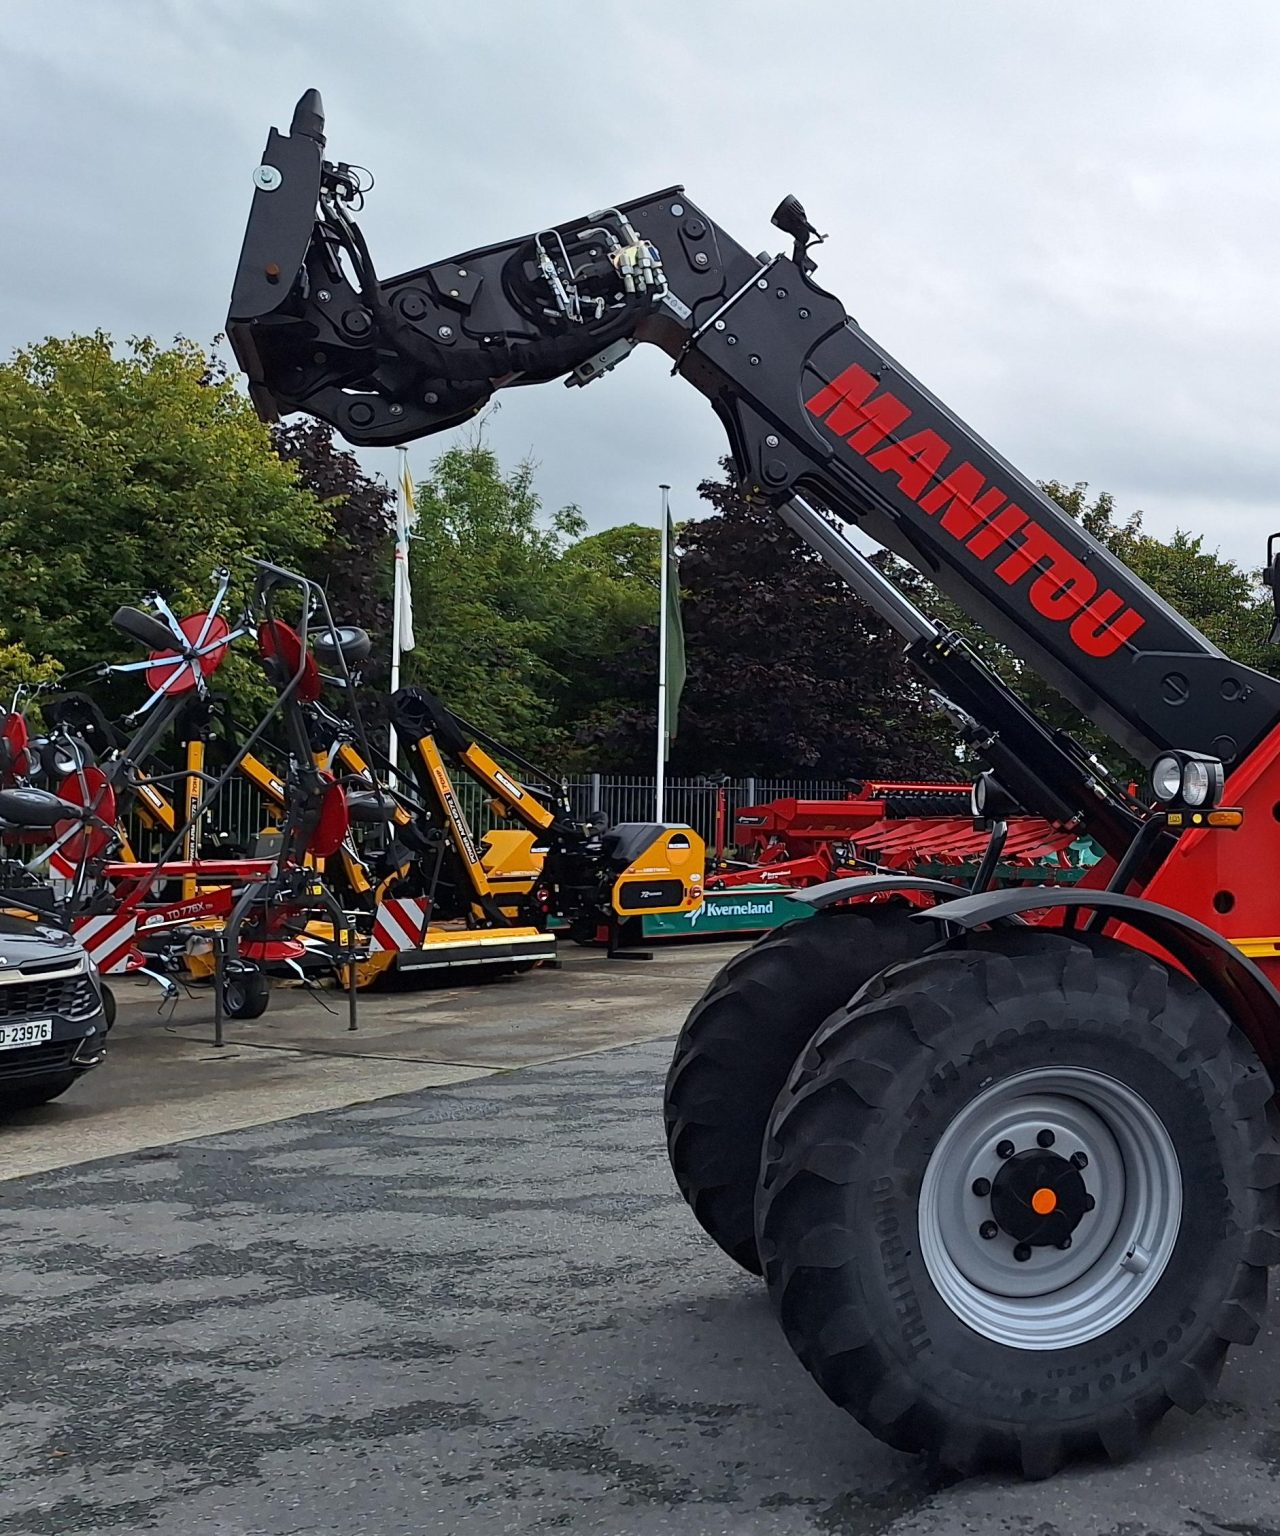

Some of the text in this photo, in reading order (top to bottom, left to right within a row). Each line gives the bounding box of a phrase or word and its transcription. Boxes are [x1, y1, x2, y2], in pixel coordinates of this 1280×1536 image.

[804, 362, 1146, 657] MANITOU
[456, 819, 466, 836] ARM
[706, 900, 773, 916] Kverneland
